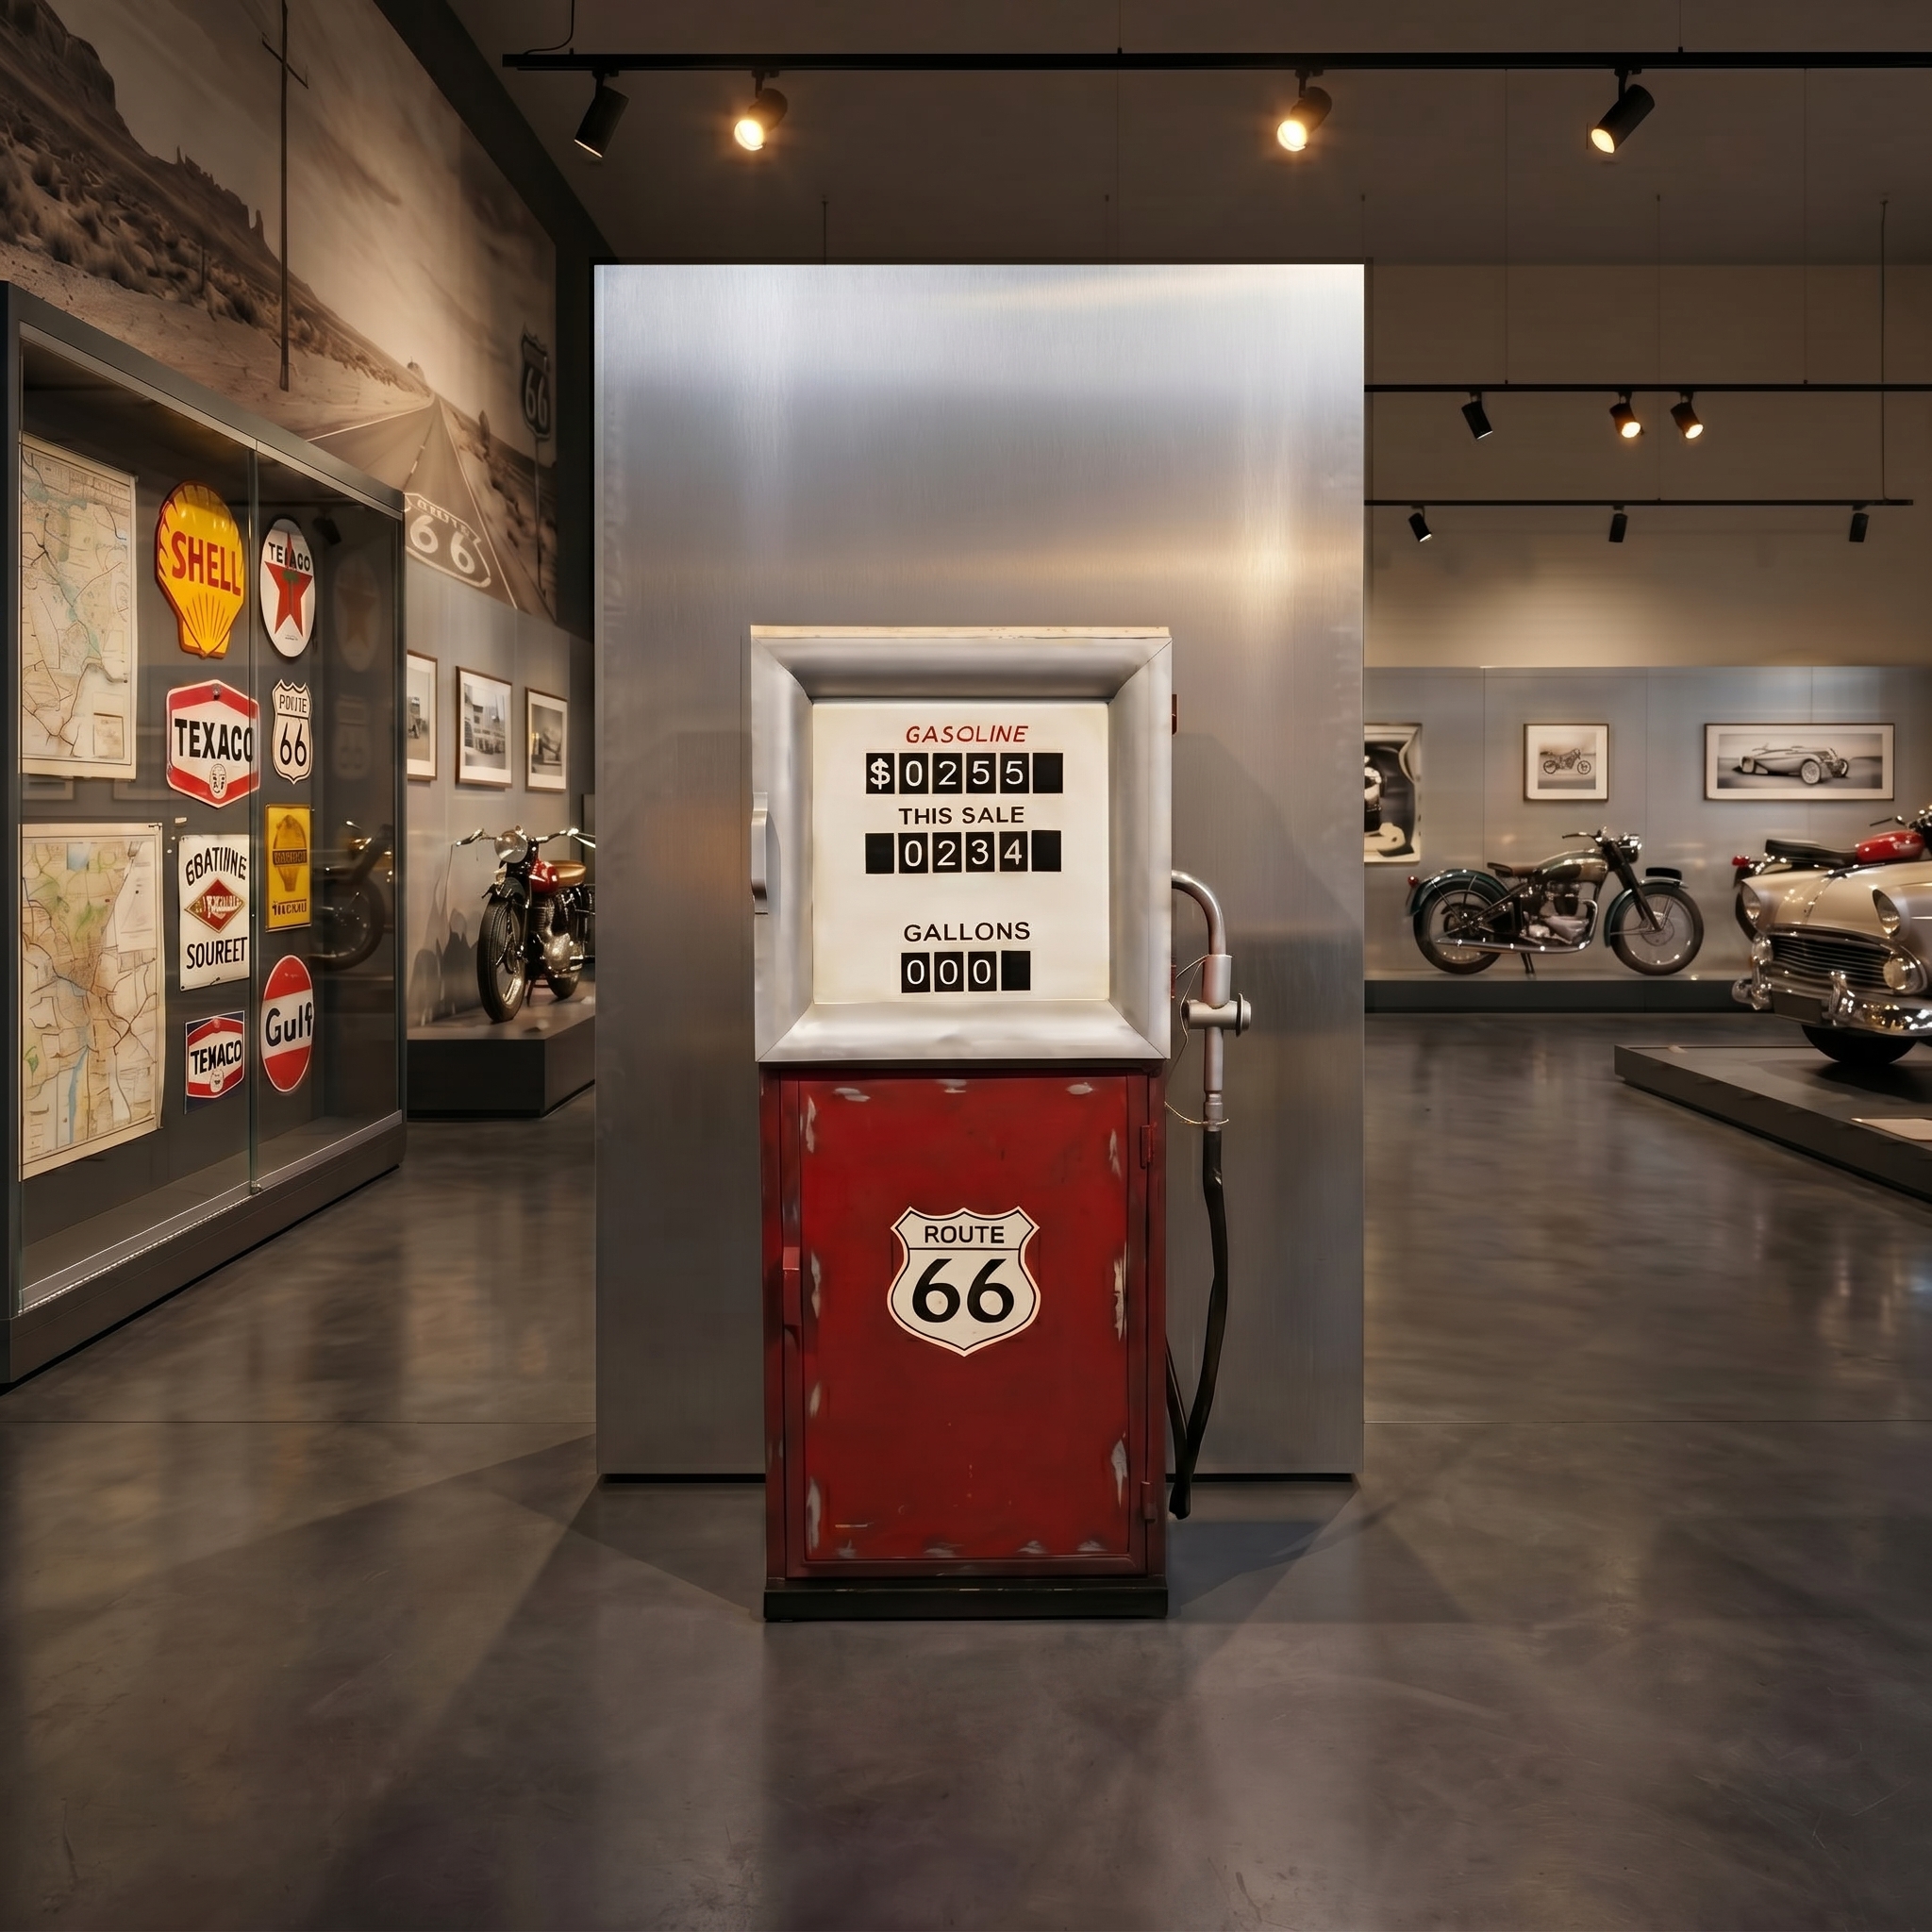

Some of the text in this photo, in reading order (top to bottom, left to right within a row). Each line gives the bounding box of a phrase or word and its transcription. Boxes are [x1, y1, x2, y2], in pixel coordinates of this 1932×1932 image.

[525, 367, 548, 428] 66
[171, 530, 242, 596] SHELL
[409, 515, 475, 574] 66
[174, 718, 254, 763] TEXACO
[280, 723, 307, 767] 66
[906, 724, 1029, 743] GASOLINE
[898, 806, 1024, 825] THIS SALE
[904, 839, 1023, 867] 0234
[904, 922, 1030, 941] GALLONS
[186, 937, 247, 970] SOUREET
[907, 959, 991, 985] 000
[265, 1001, 313, 1047] Gulf
[924, 1225, 1005, 1243] ROUTE
[911, 1257, 1015, 1324] 66
